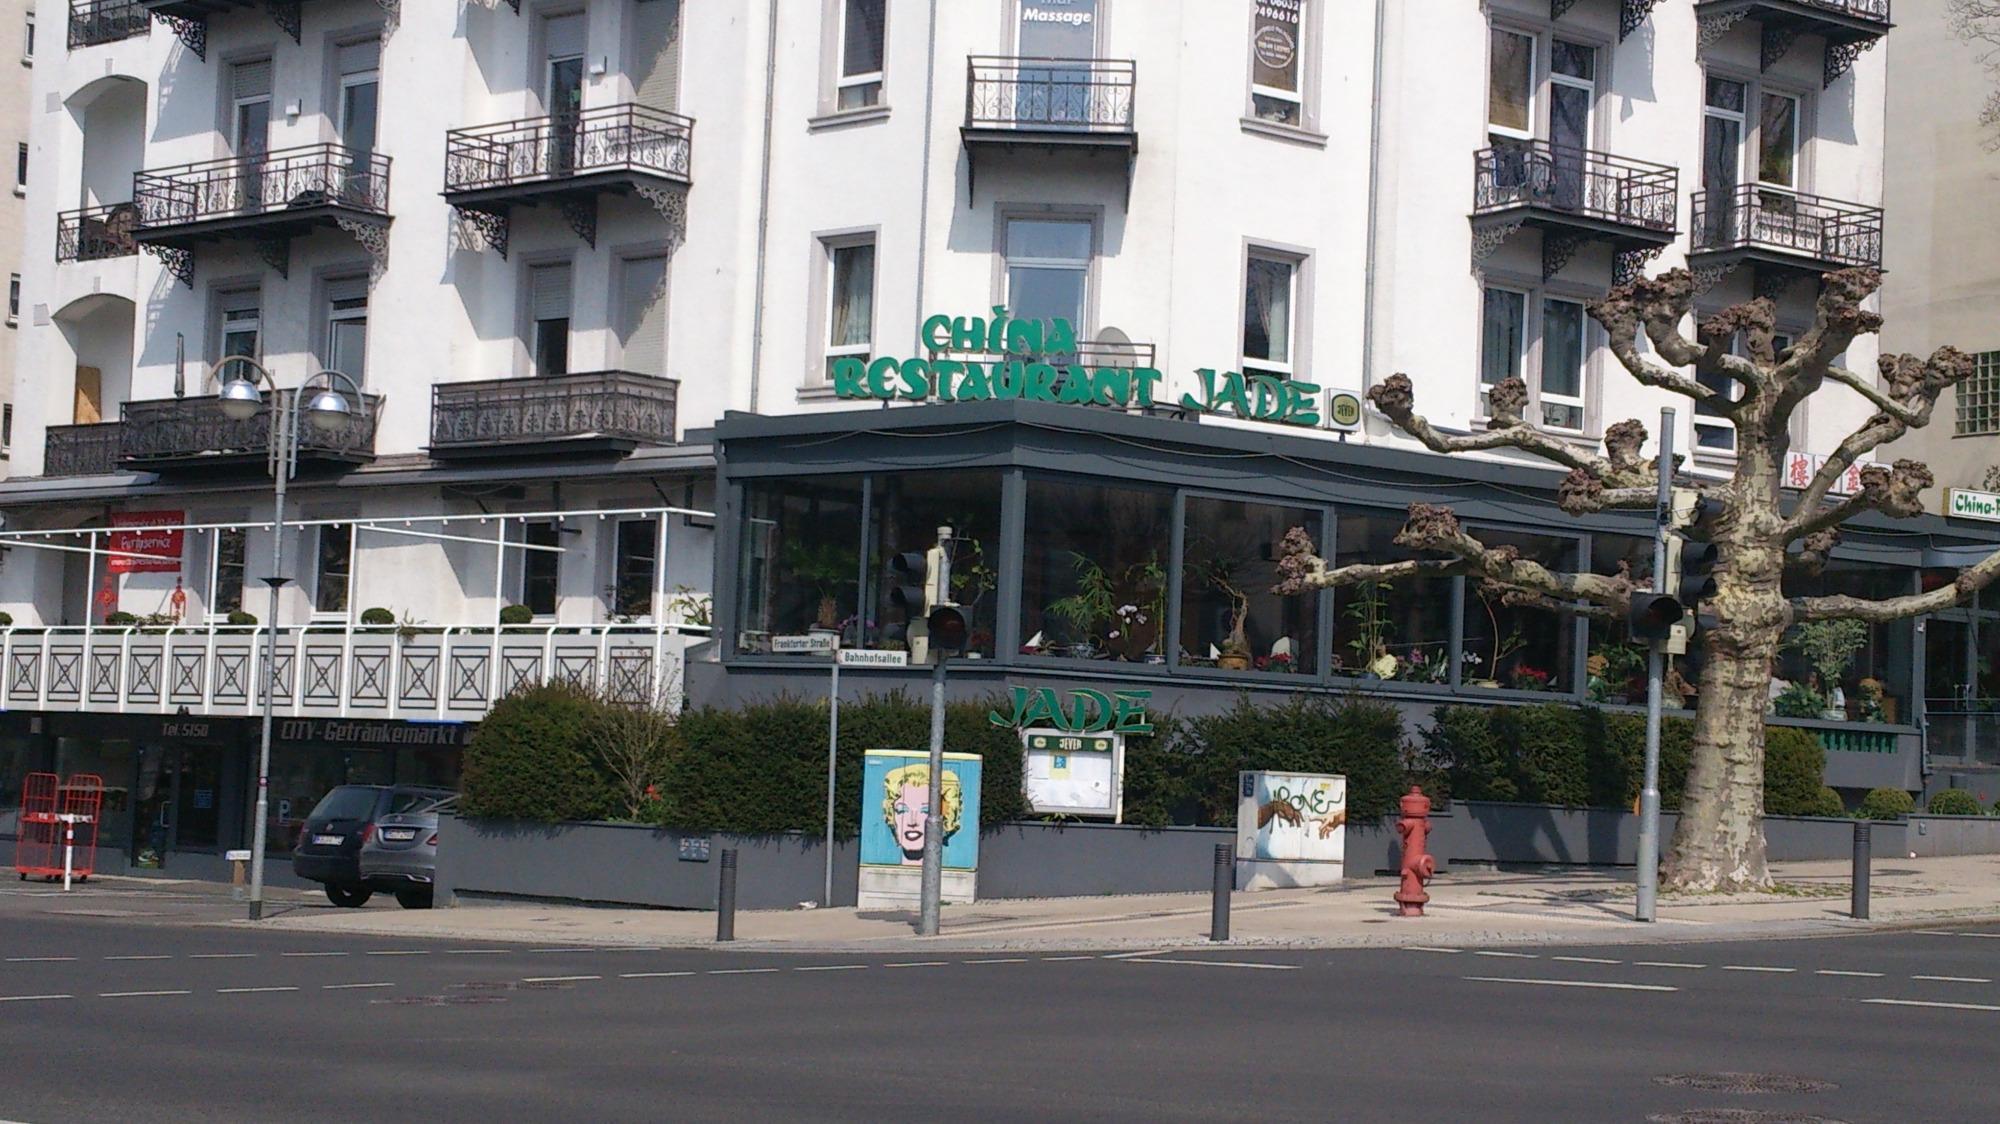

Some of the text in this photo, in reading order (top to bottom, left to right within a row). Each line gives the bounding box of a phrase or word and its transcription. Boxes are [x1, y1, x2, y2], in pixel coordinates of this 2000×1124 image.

[1023, 8, 1092, 26] Massage
[831, 356, 1321, 427] RESTAURANT JADE
[774, 638, 831, 649] Frankfurter Straße
[844, 651, 903, 664] Bahnhofsallee
[988, 684, 1155, 733] JADE
[1059, 737, 1082, 750] JEVER
